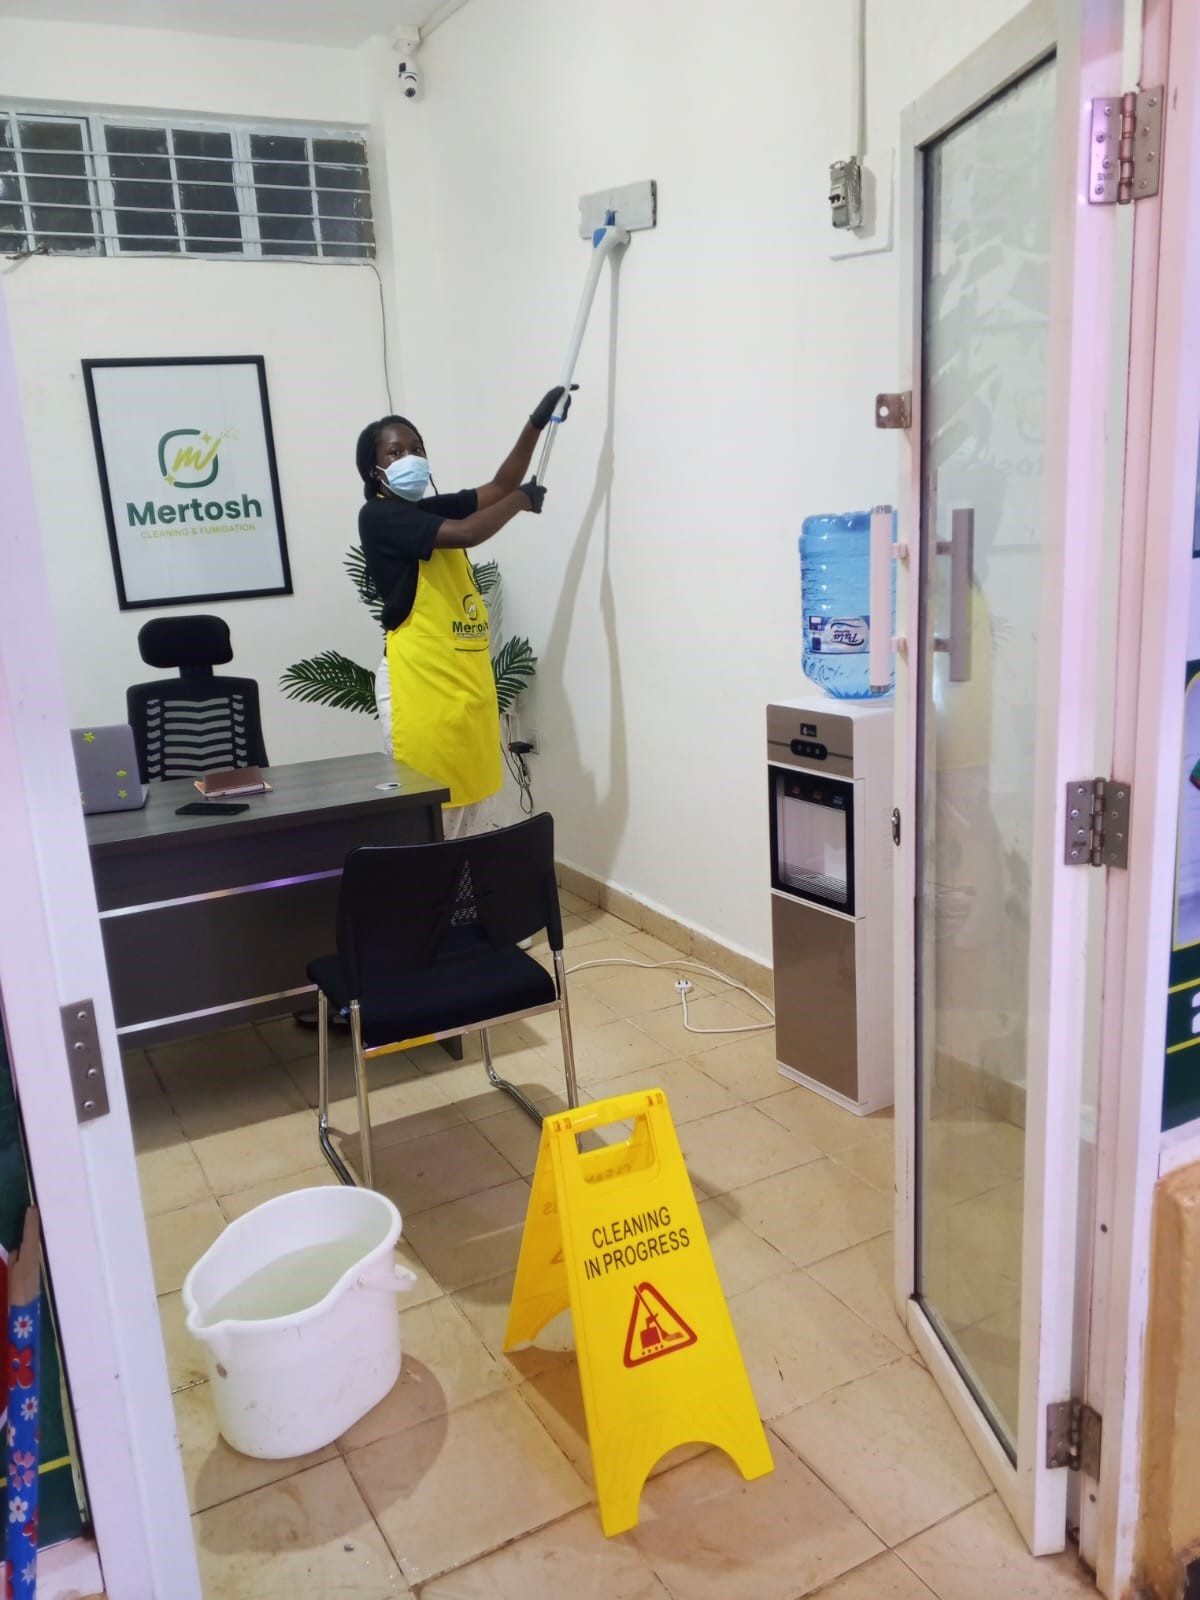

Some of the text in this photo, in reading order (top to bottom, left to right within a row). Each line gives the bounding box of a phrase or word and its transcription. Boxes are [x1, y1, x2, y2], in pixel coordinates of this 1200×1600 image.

[126, 493, 262, 526] Mertosh
[140, 523, 256, 539] CLEANING & FUMIGATION
[592, 1206, 671, 1248] CLEANING
[584, 1227, 690, 1280] IN PROGRESS
